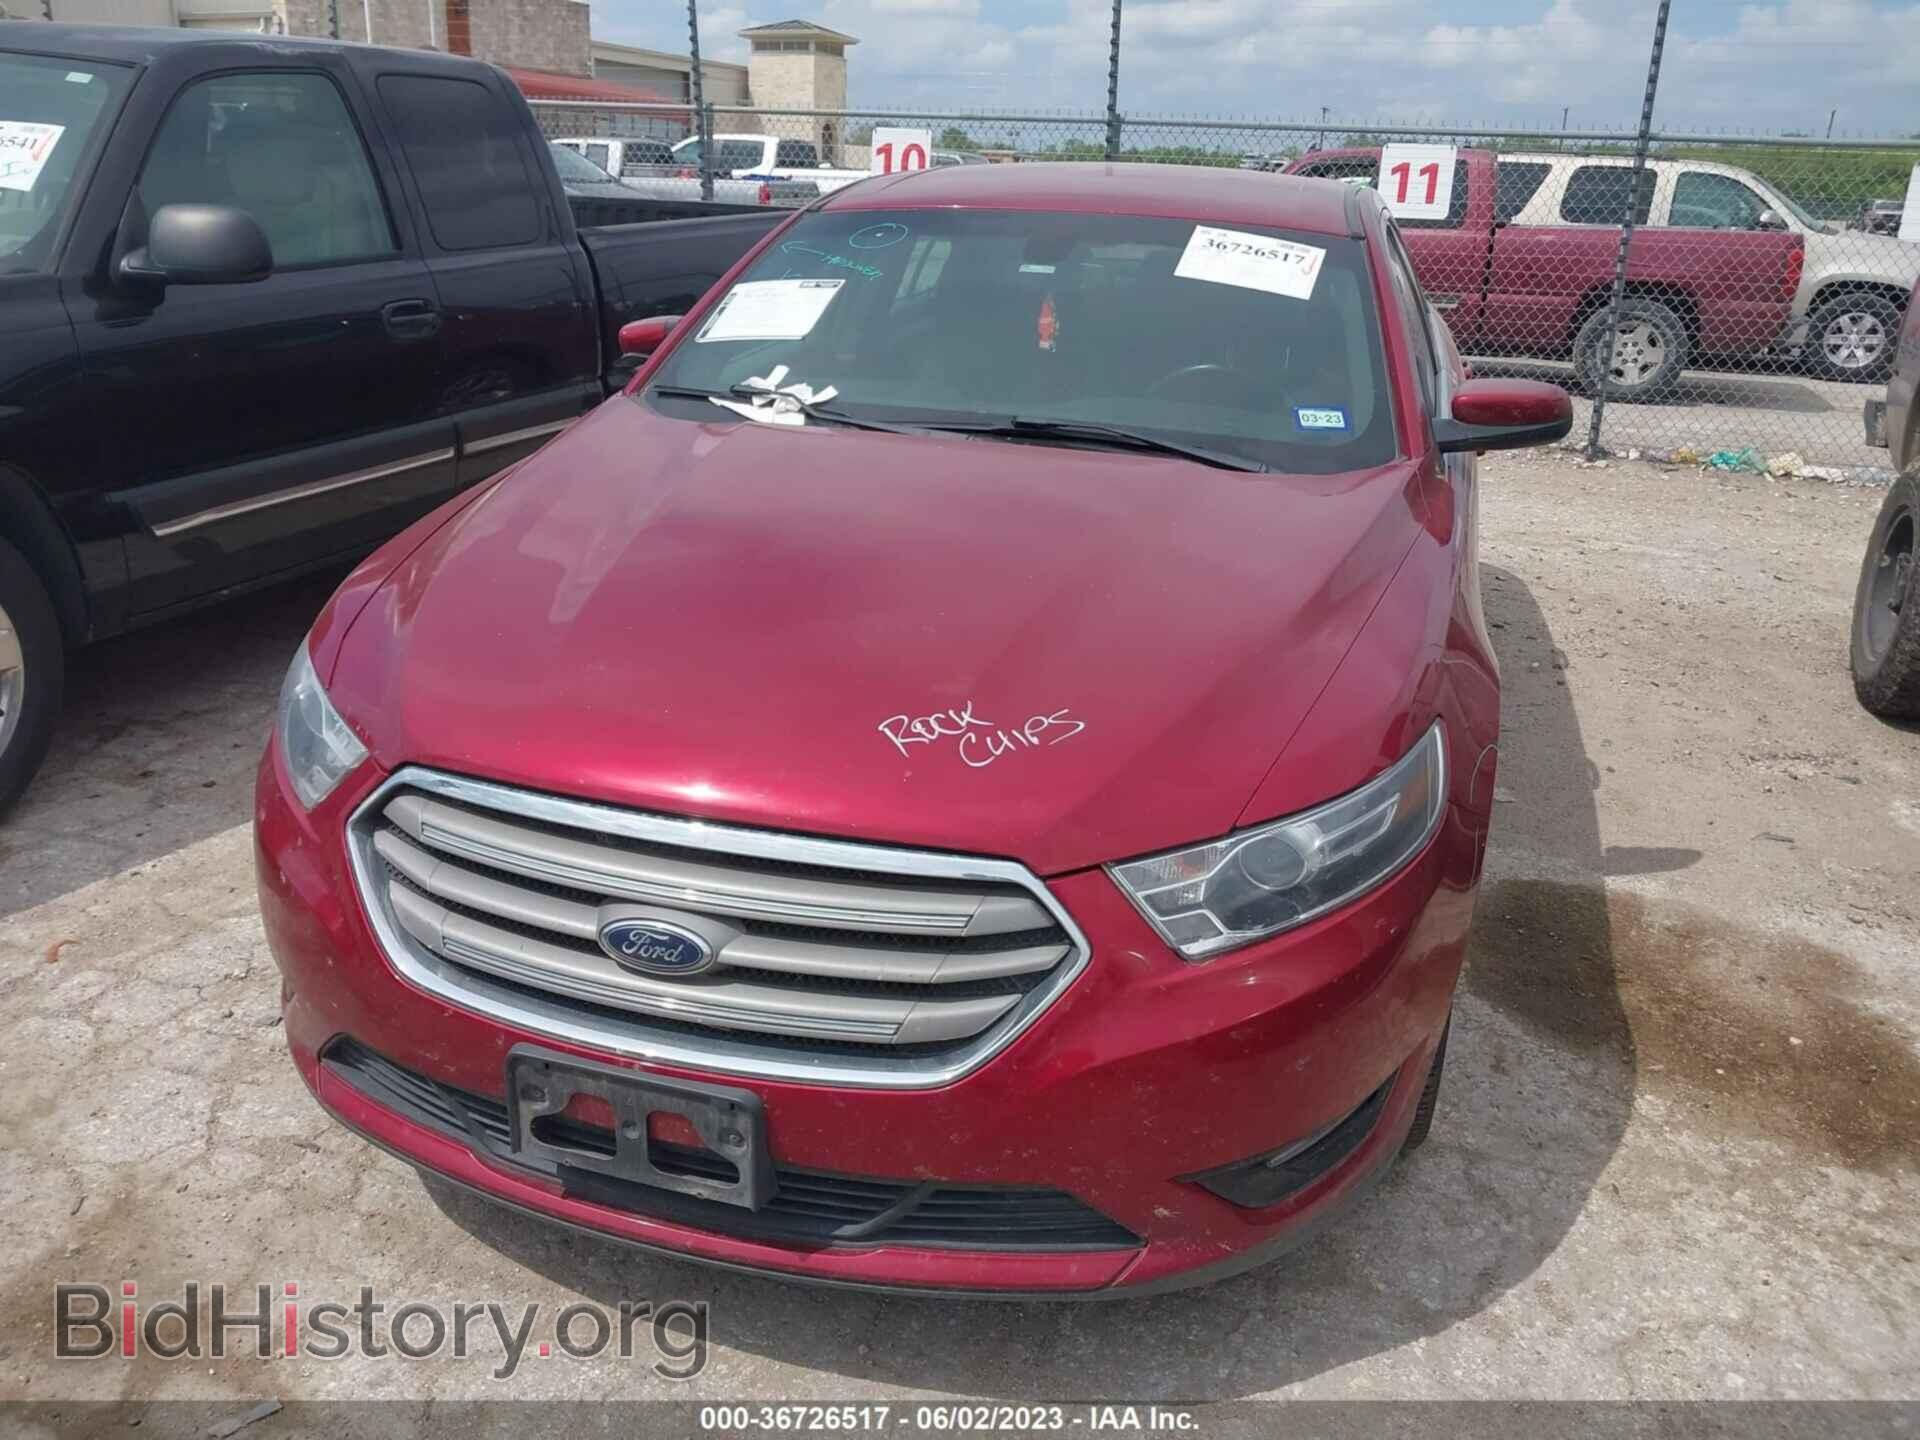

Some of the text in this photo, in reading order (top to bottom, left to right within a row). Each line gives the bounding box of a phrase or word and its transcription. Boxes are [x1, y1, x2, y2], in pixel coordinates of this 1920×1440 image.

[876, 143, 926, 176] 10
[1391, 162, 1439, 205] 11
[1202, 237, 1306, 266] 36726517
[1301, 413, 1342, 425] 03-23
[878, 700, 995, 758] ROCK
[959, 708, 1085, 767] CHIPS
[621, 929, 685, 963] Ford
